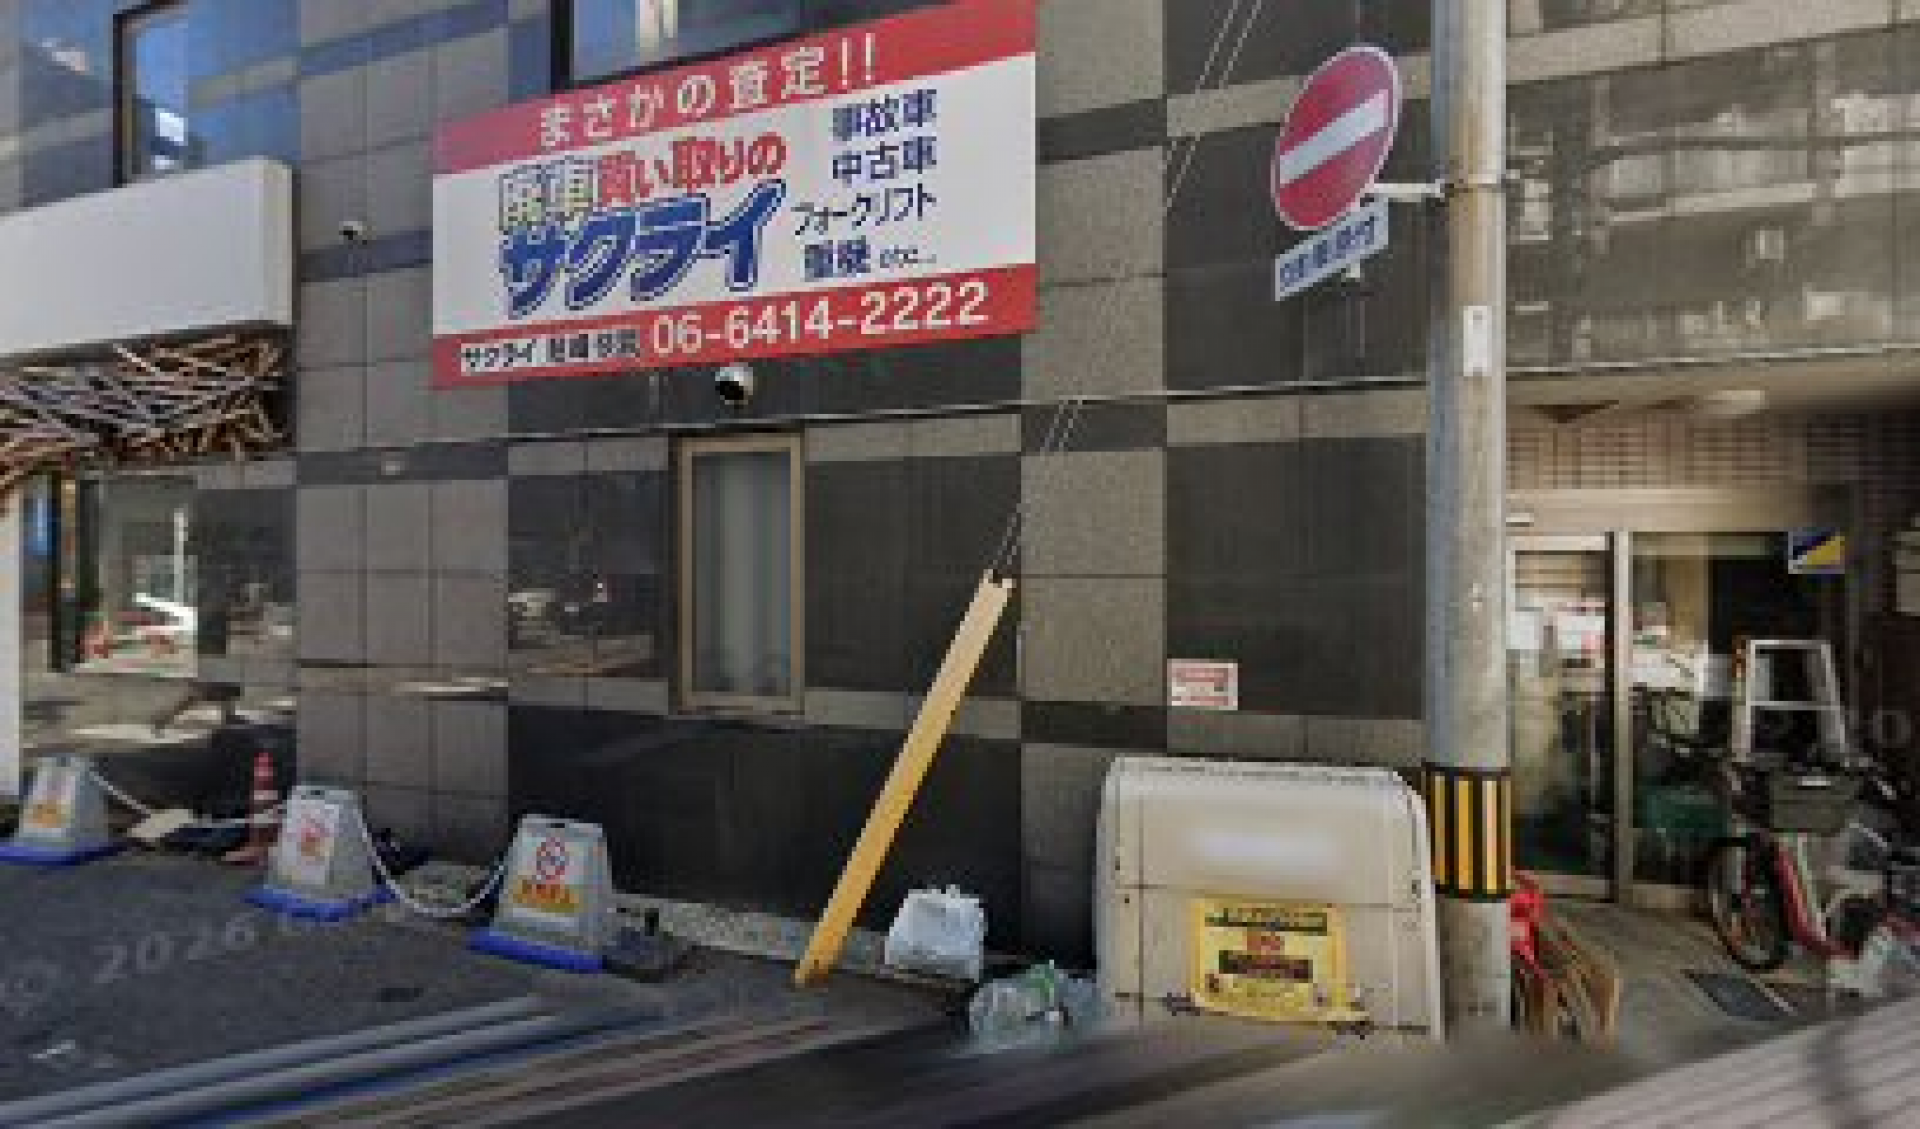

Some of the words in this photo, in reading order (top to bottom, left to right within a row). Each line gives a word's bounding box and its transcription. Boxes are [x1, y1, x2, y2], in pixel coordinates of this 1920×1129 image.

[833, 137, 937, 184] 中古車
[790, 183, 937, 236] フォークリフト
[502, 178, 787, 320] サクライ
[653, 281, 988, 355] 06-6414-2222
